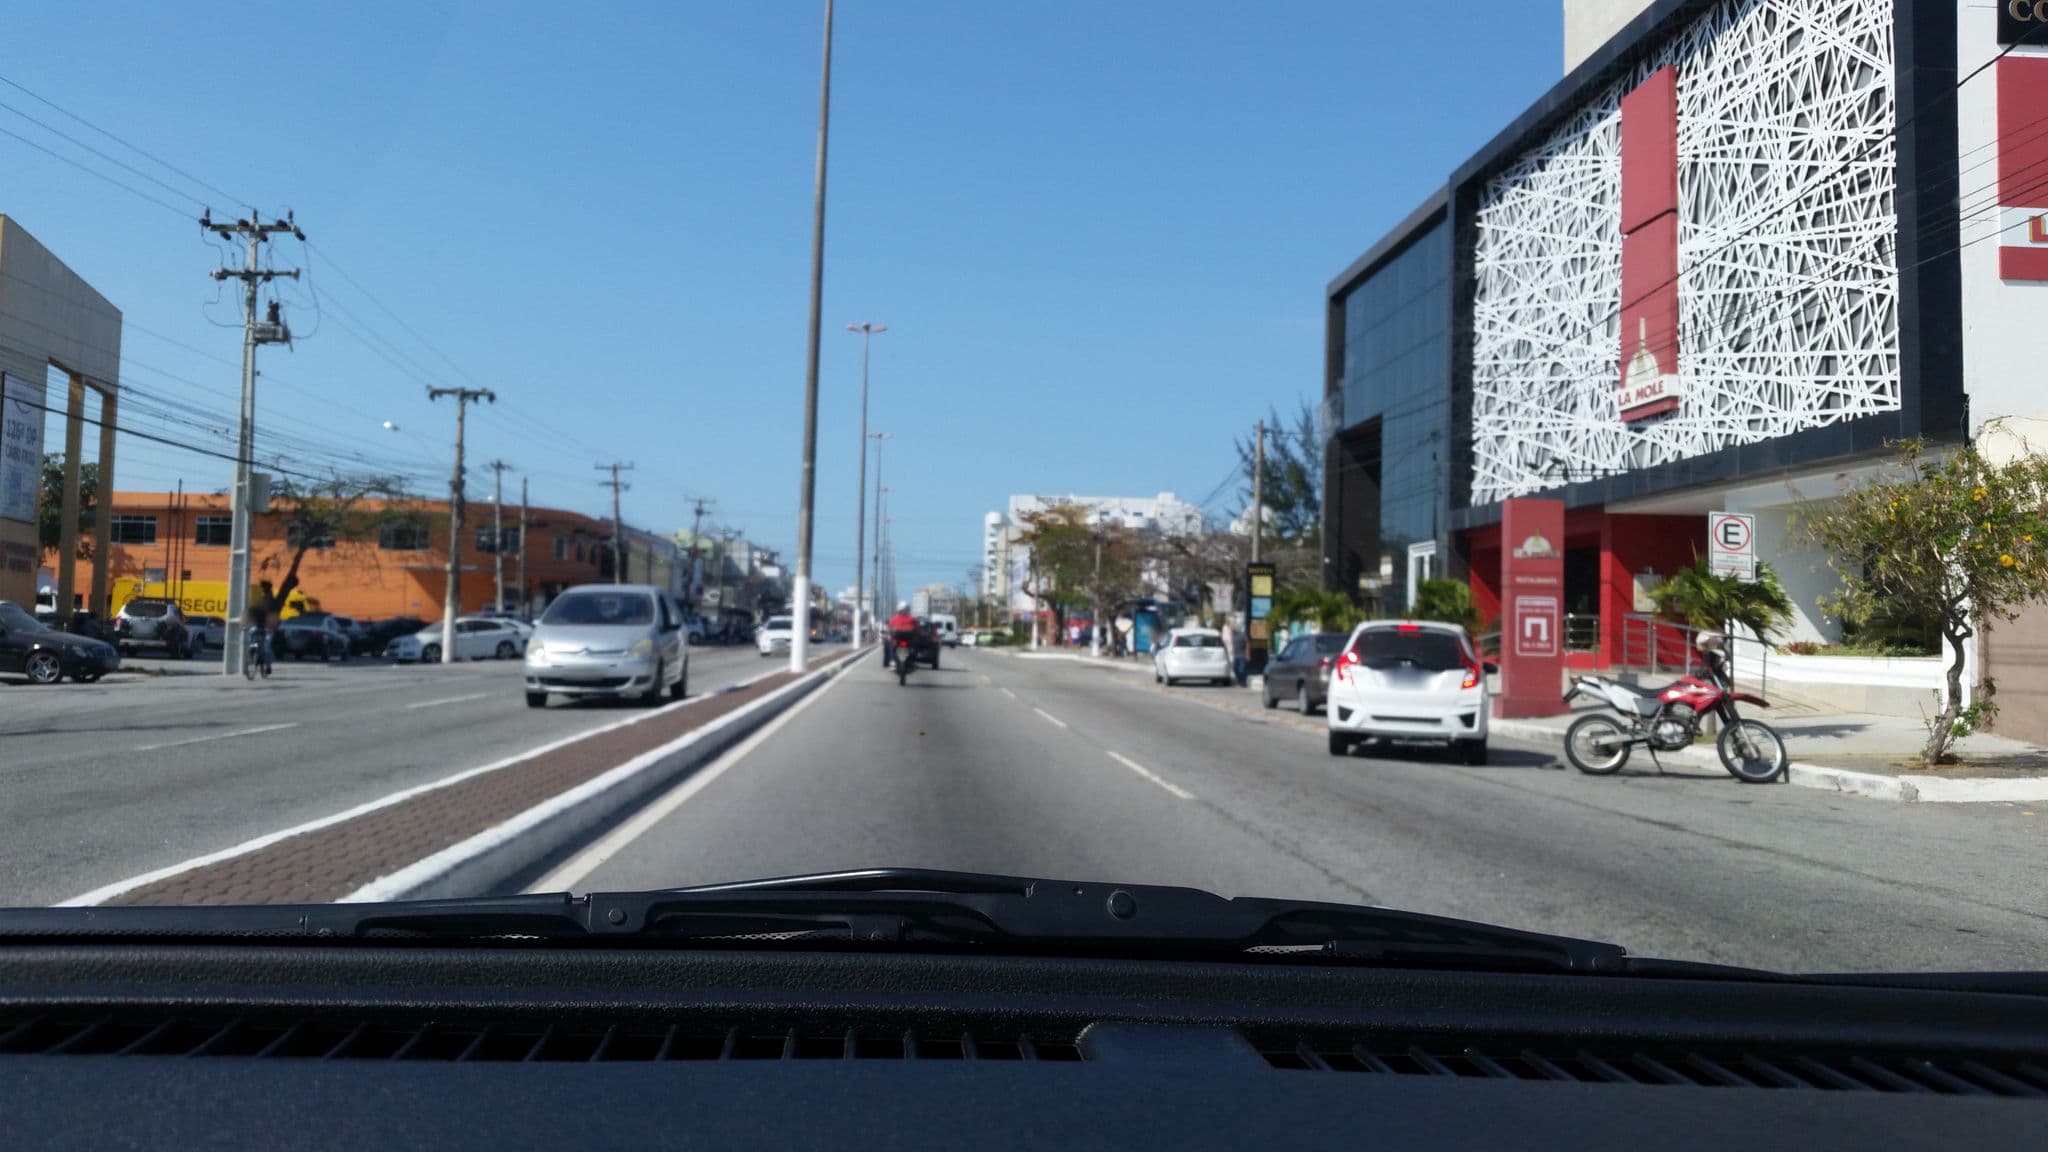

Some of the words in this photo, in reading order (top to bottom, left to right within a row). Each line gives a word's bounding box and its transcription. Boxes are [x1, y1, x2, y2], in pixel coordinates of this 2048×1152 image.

[1618, 391, 1631, 406] LA
[1635, 380, 1664, 402] MOLE
[1723, 523, 1741, 545] E
